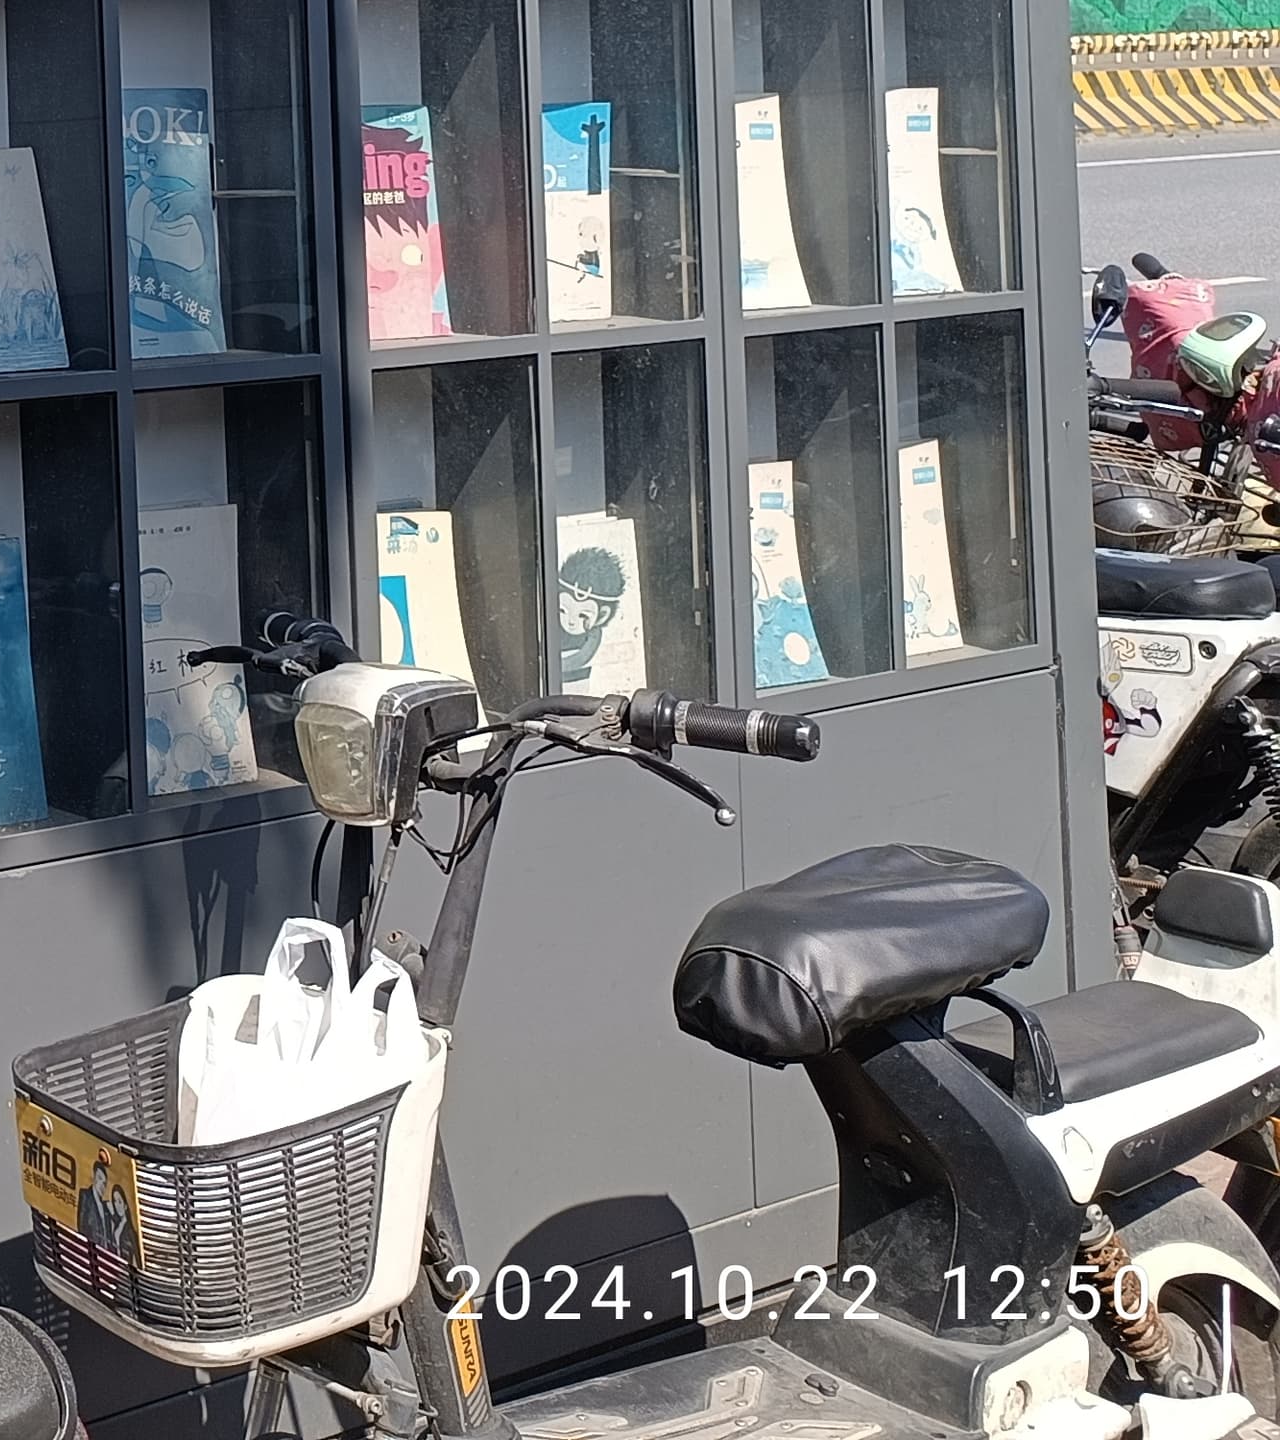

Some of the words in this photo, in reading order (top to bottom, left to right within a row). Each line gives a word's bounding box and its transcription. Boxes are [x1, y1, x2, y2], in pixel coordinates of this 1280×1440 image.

[123, 105, 204, 147] OK!
[363, 142, 430, 199] ing
[22, 1130, 77, 1191] 新日
[22, 1169, 78, 1208] 全智能电动车
